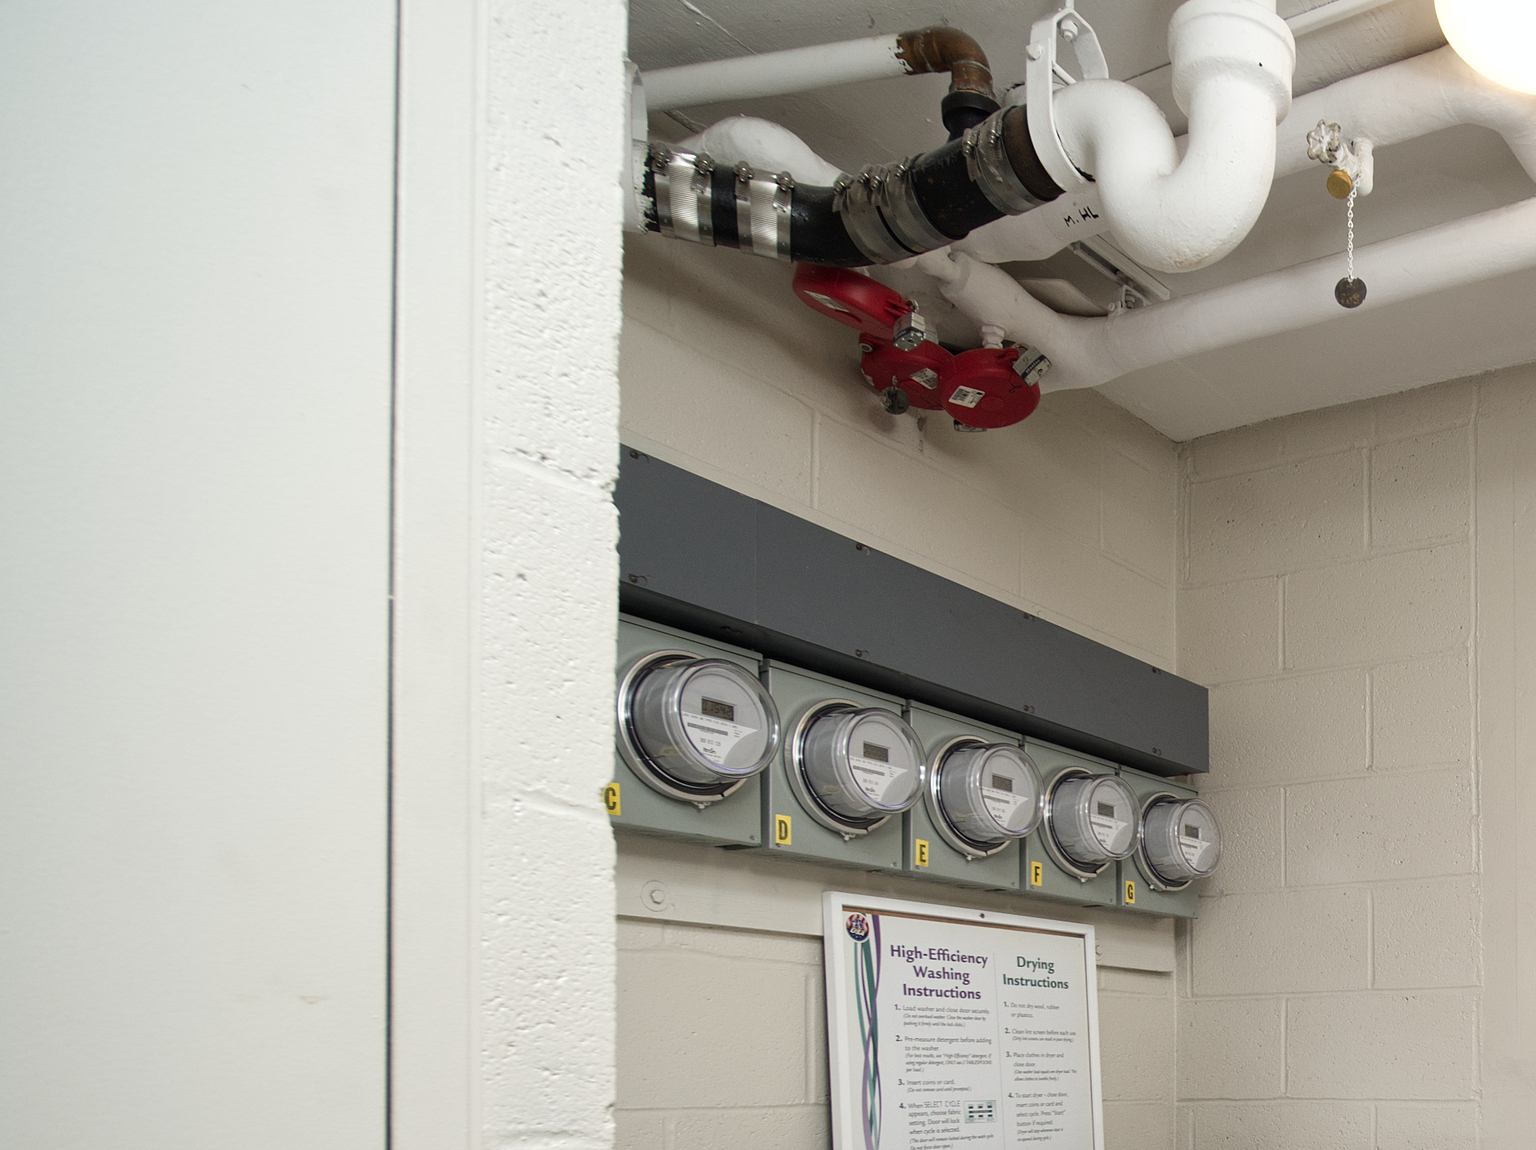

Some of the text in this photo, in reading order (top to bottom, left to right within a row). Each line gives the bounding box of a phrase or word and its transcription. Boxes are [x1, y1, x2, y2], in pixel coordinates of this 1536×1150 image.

[604, 787, 616, 810] C
[779, 820, 788, 840] D
[920, 844, 926, 862] E
[1035, 866, 1040, 882] F
[1128, 884, 1133, 899] G
[890, 945, 988, 968] High-Efficiency
[1017, 956, 1054, 974] Drying
[913, 966, 970, 985] Washing
[1003, 974, 1069, 989] Instructions
[903, 984, 981, 999] Instructions
